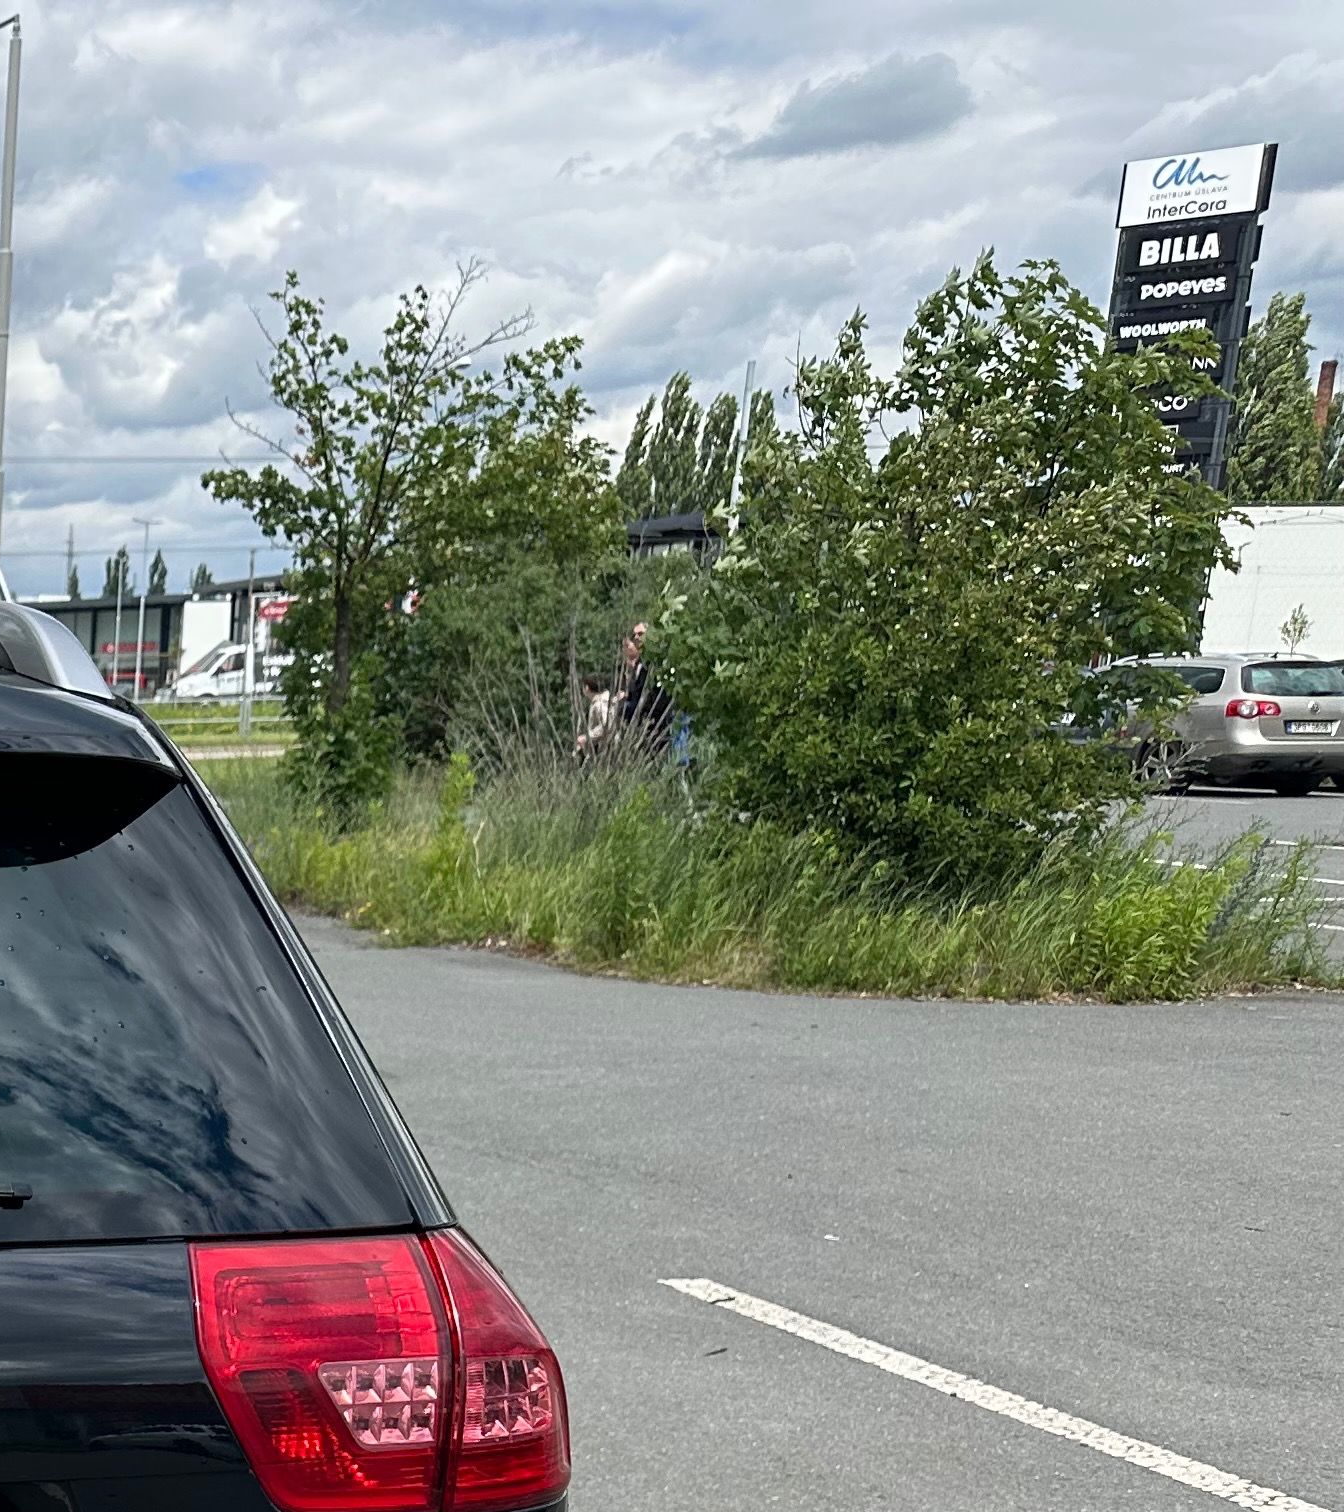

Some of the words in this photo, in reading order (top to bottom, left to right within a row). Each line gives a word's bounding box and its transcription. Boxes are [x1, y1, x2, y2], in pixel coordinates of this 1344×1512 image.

[1149, 189, 1191, 202] CENTRUM
[1146, 198, 1227, 220] InterCora
[1138, 232, 1220, 267] BILLA
